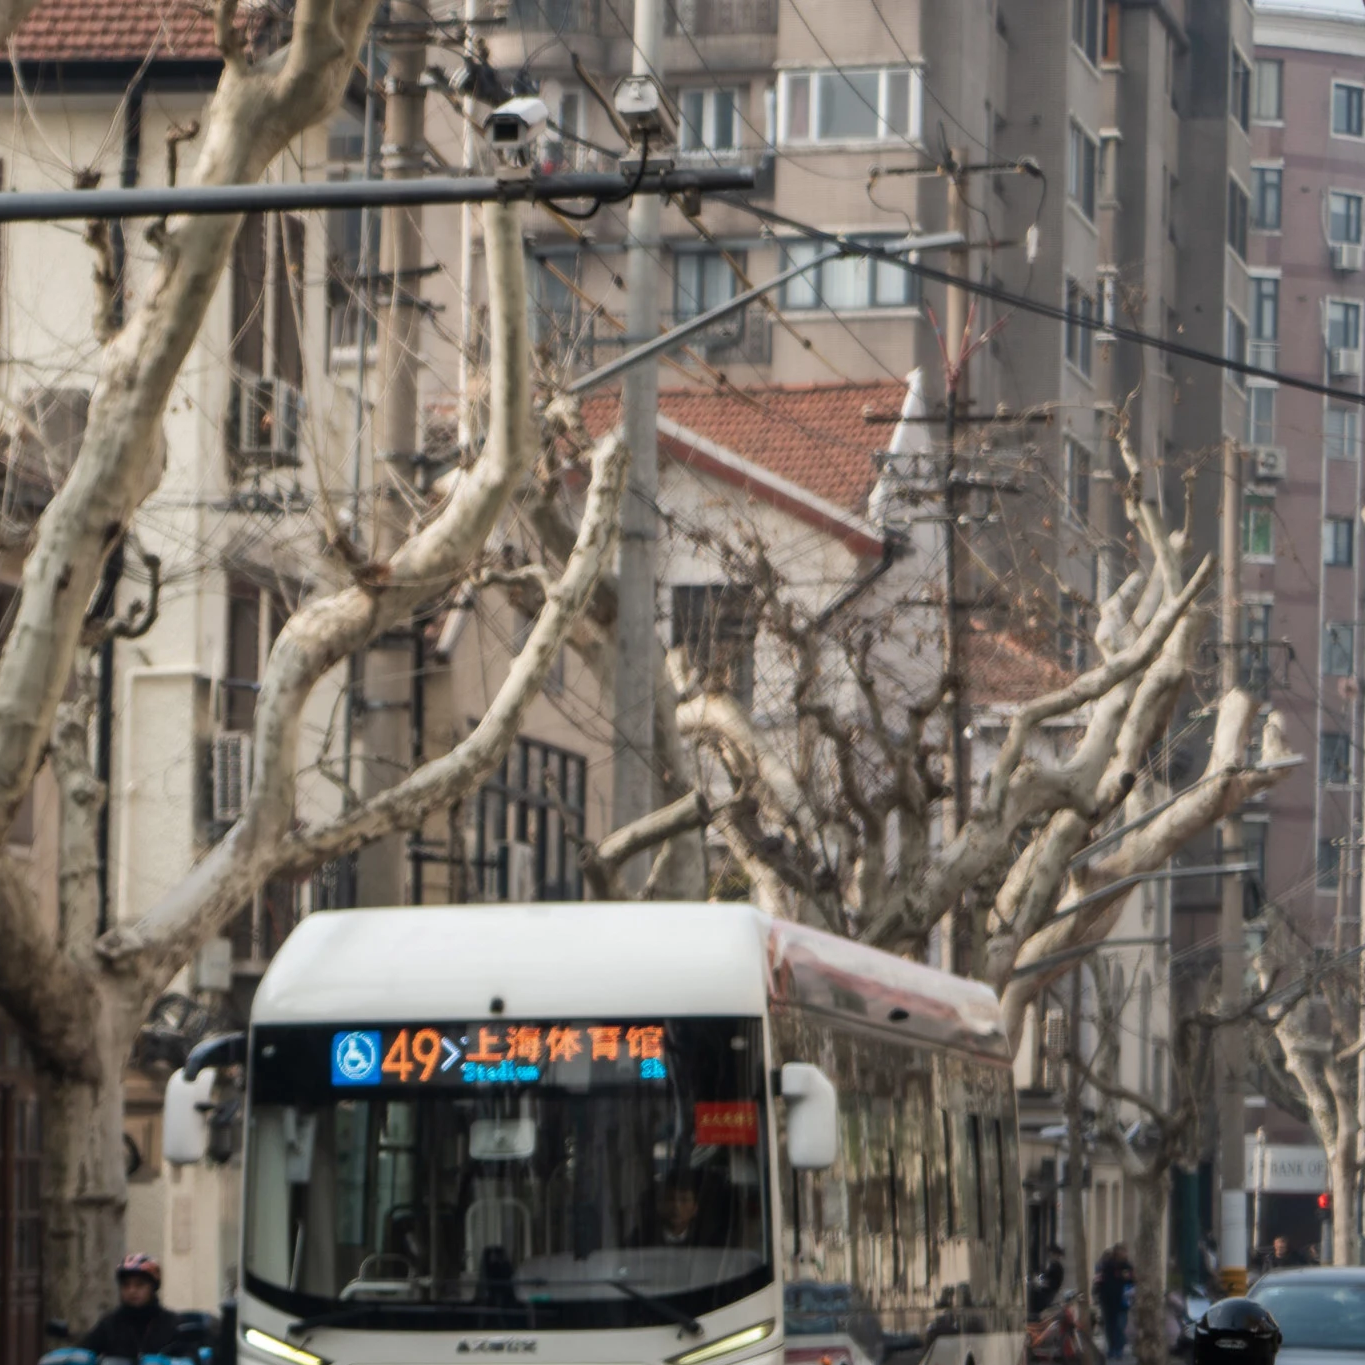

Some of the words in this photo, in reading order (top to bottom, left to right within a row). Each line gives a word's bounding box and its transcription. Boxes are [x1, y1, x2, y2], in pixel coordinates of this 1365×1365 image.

[466, 1026, 664, 1063] 上海体育馆
